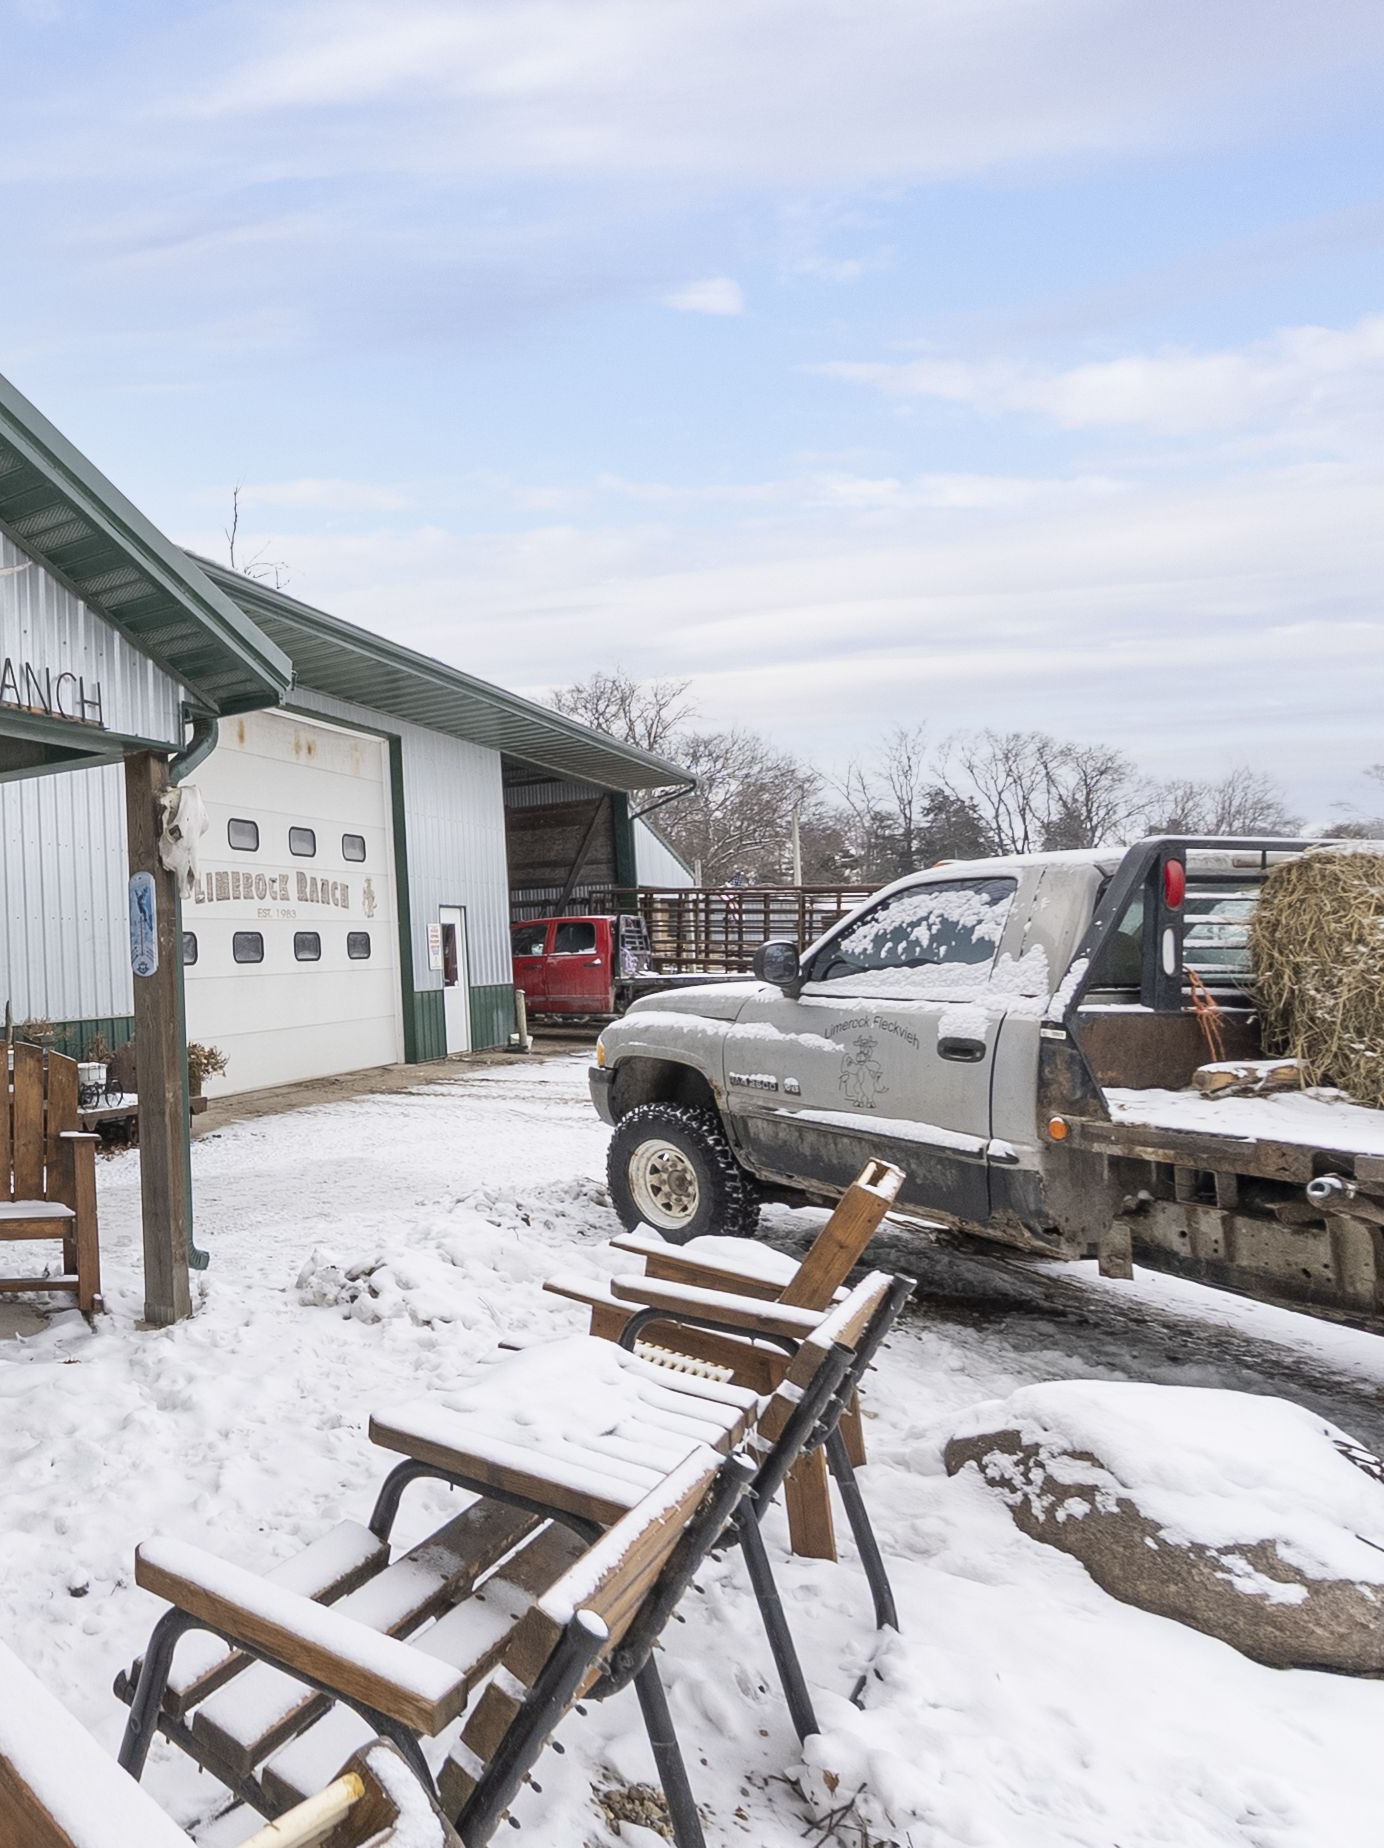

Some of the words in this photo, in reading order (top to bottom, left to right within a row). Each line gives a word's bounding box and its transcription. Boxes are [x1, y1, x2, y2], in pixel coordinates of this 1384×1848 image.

[296, 871, 350, 909] RANCH
[824, 1016, 871, 1040] Limerock
[874, 1015, 920, 1050] Fleckvieh
